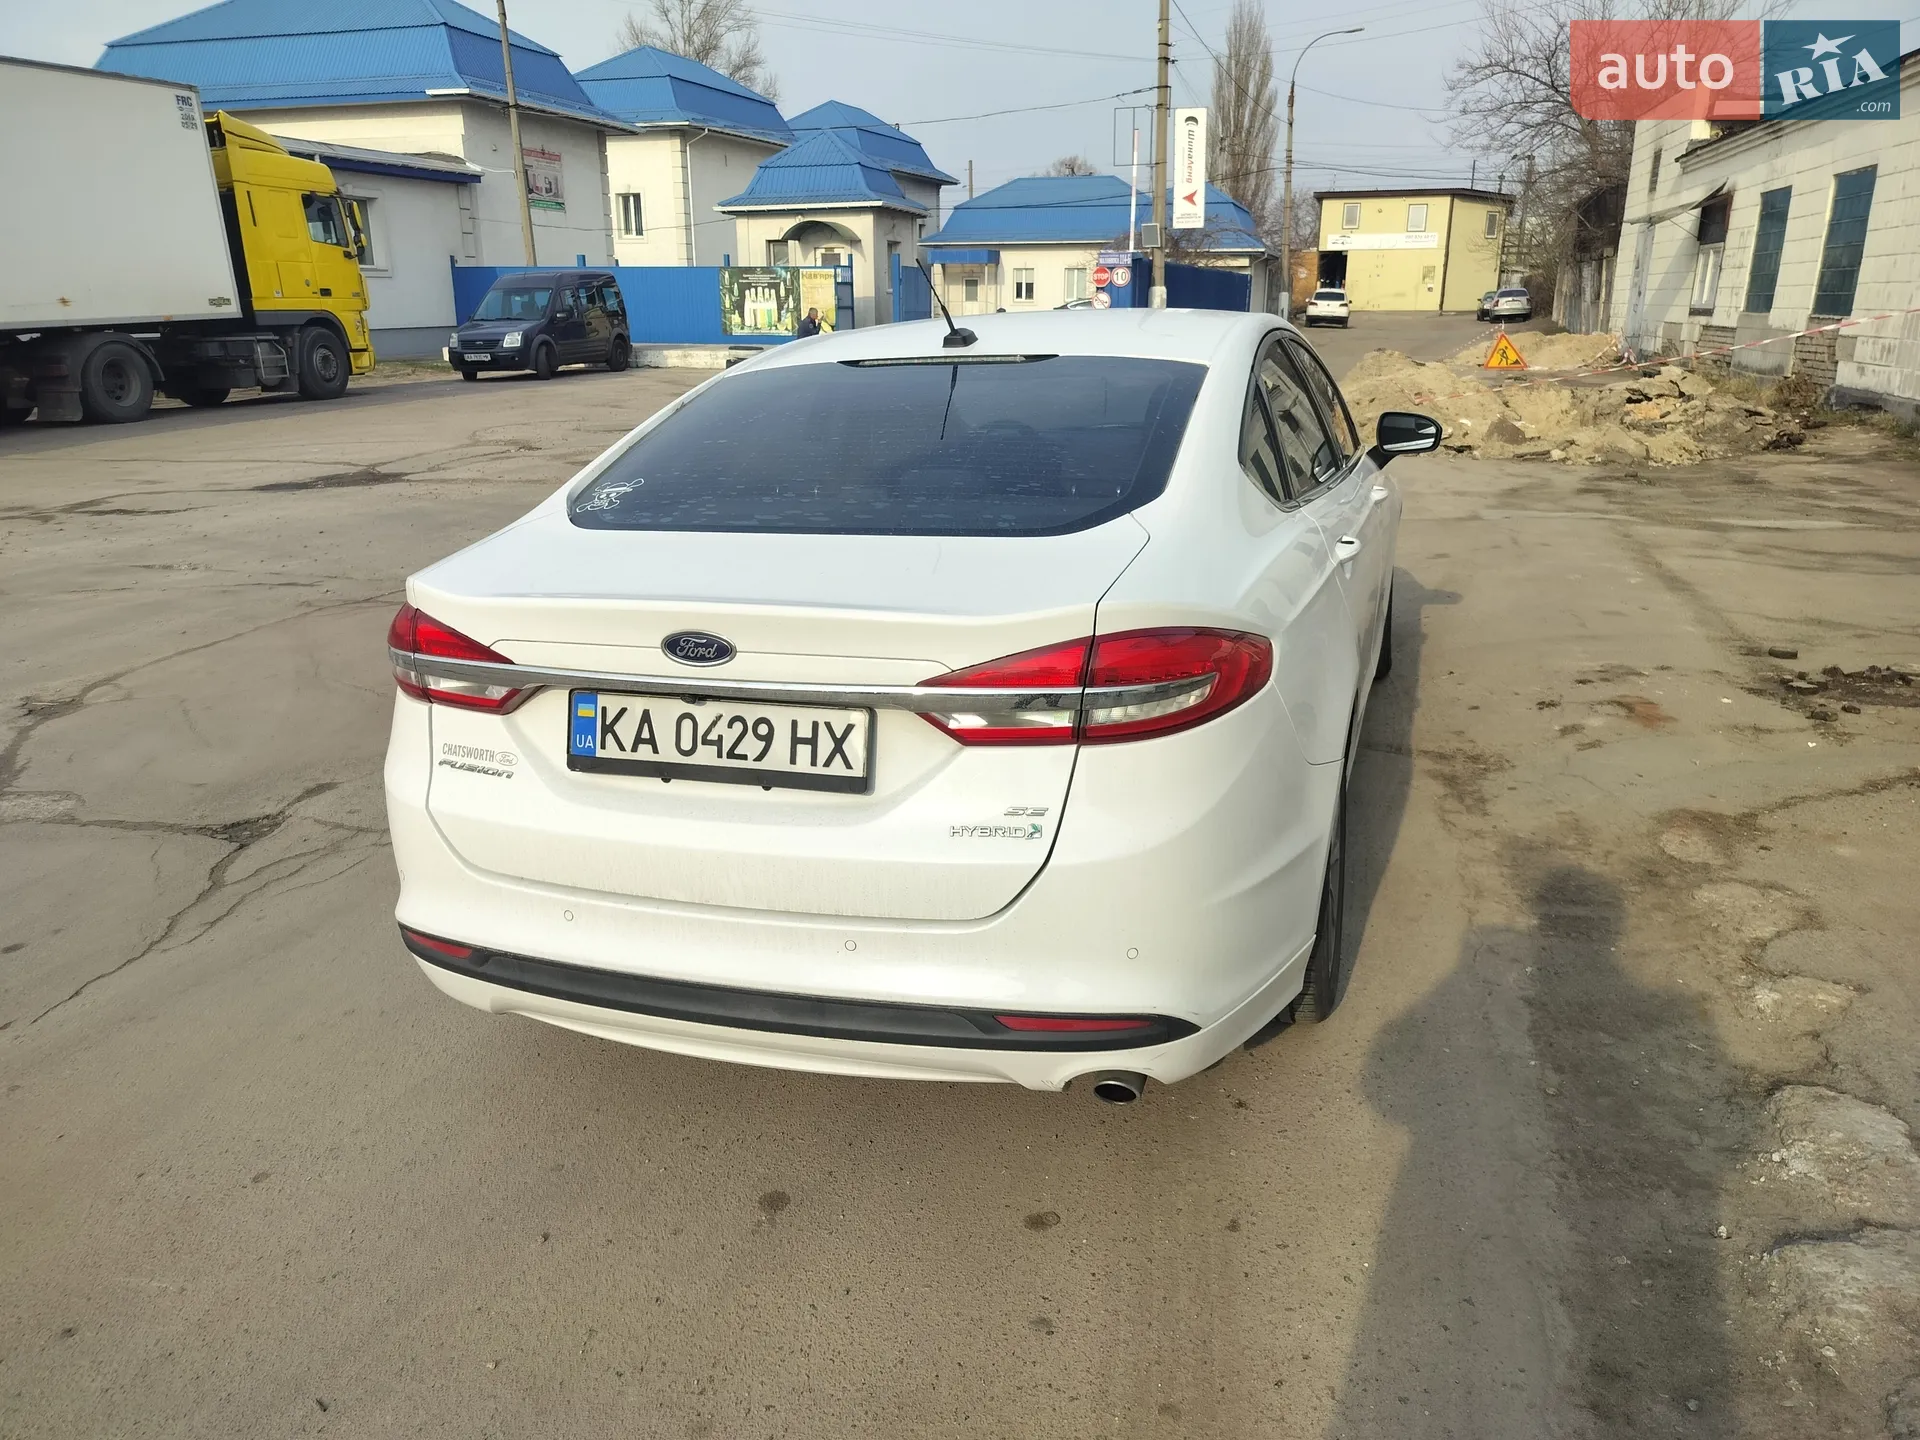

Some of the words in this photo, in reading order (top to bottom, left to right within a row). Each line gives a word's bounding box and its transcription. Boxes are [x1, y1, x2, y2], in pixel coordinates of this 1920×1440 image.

[175, 94, 193, 107] FRC
[1093, 273, 1109, 281] STOP
[1115, 271, 1127, 281] 10
[676, 637, 718, 659] Ford
[576, 734, 594, 749] UA
[600, 706, 660, 754] KA
[674, 712, 775, 762] 0429
[789, 719, 855, 770] HX
[442, 742, 495, 763] CHATSWORTH
[1003, 806, 1049, 817] SE
[949, 825, 1026, 838] HYBRID
